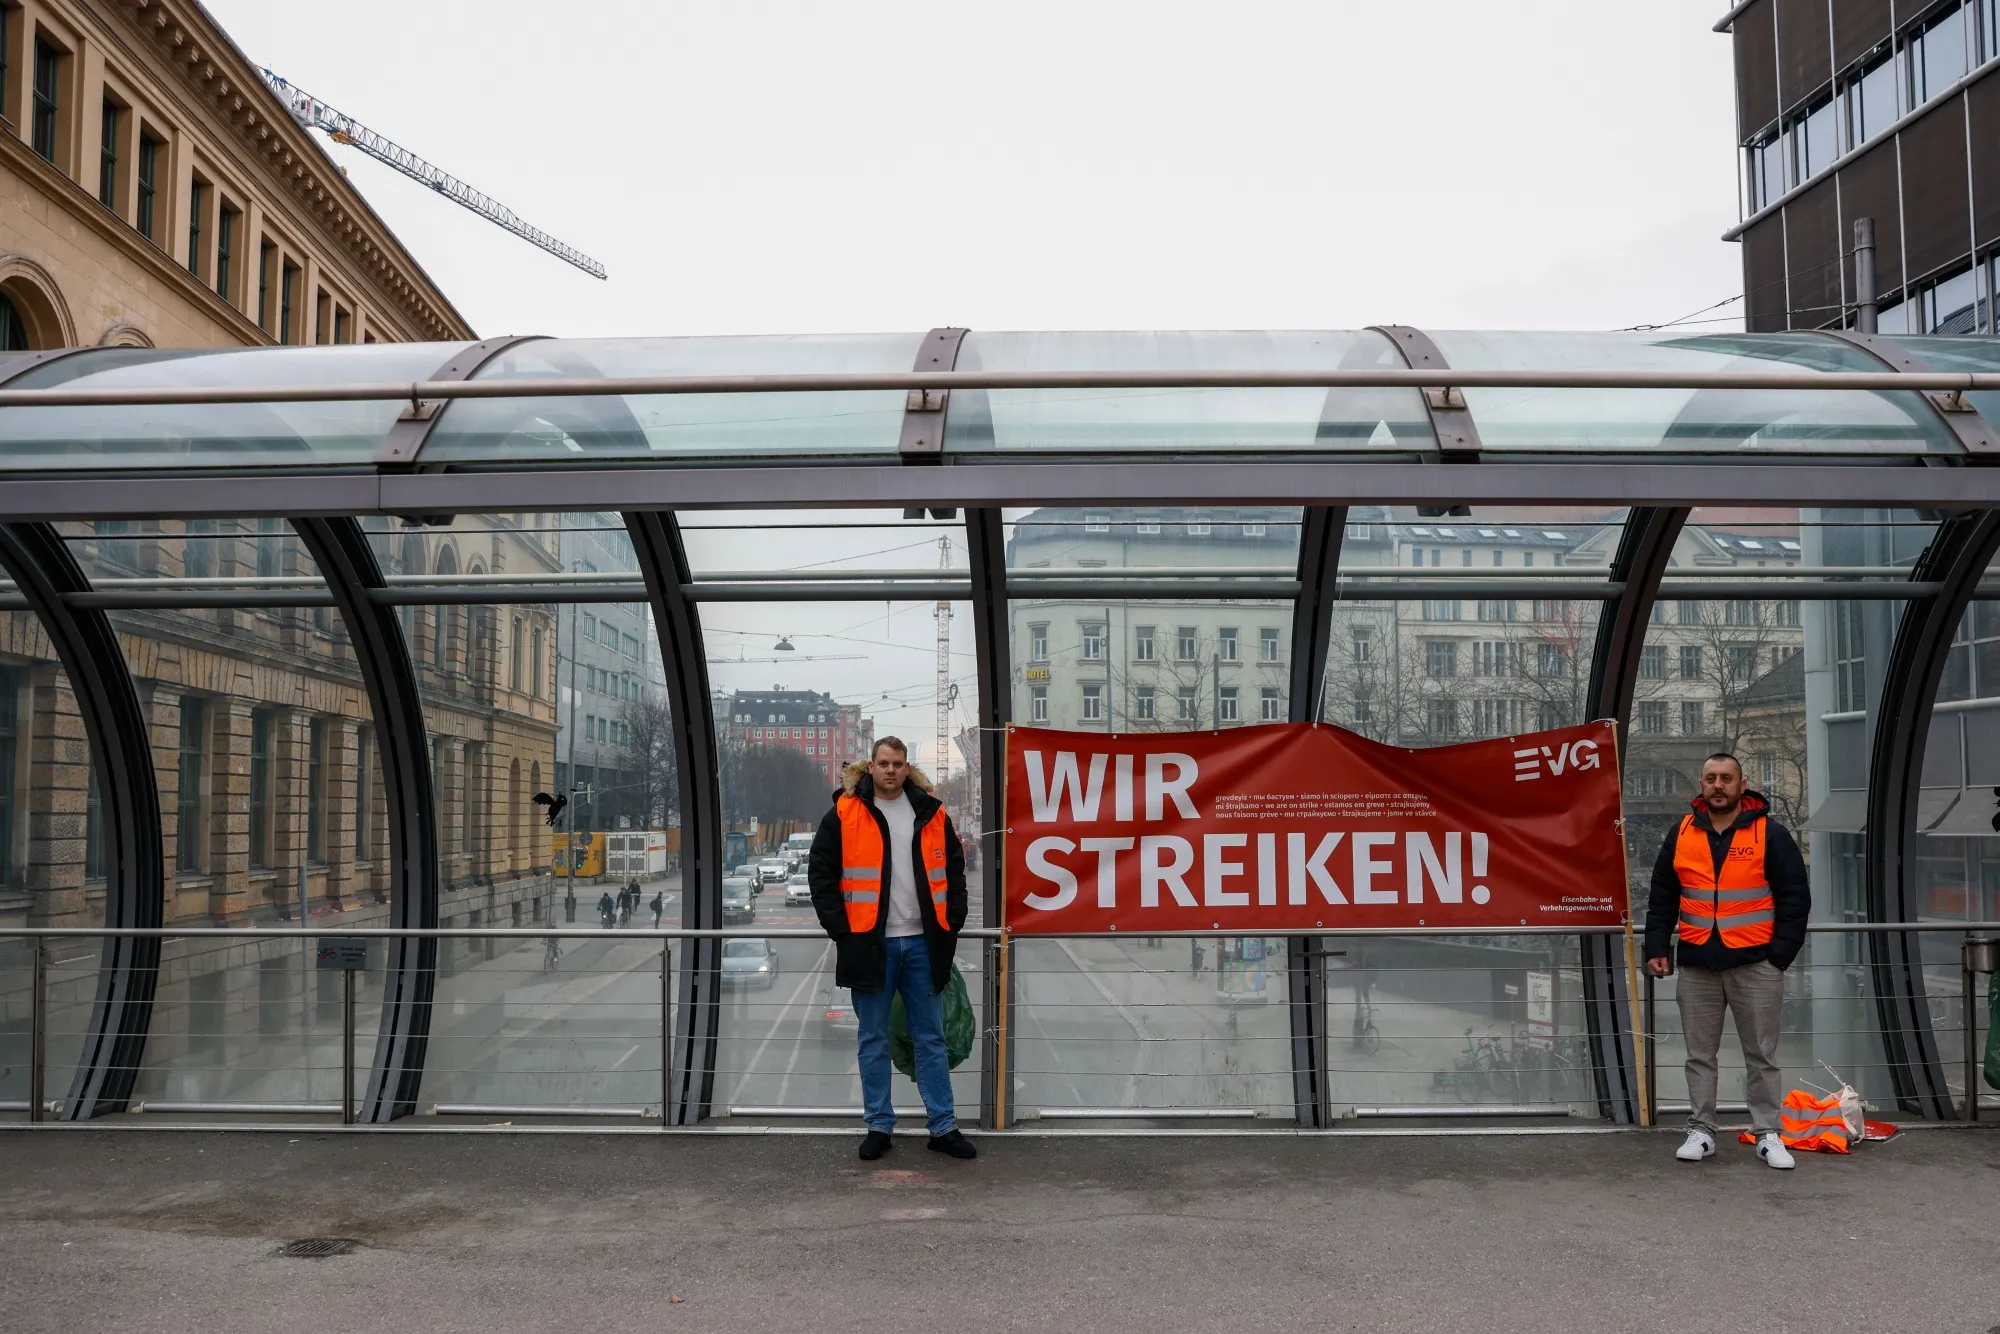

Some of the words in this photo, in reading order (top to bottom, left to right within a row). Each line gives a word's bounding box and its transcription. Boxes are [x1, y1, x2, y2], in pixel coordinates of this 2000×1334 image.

[1026, 668, 1050, 679] HOTEL
[1514, 739, 1600, 781] EVG
[1024, 750, 1201, 823] WIR
[1215, 794, 1248, 803] grevdeyiz
[1300, 792, 1321, 800] siamo
[1330, 792, 1360, 801] sciopero
[1215, 802, 1225, 810] mi
[1225, 802, 1260, 811] štrajkamo
[1299, 801, 1319, 809] strike
[1366, 801, 1385, 809] greve
[1390, 801, 1431, 809] strajkujemy
[1342, 810, 1382, 818] štrajkujeme
[1387, 809, 1404, 818] jsme
[1414, 809, 1437, 817] stávce
[1729, 847, 1754, 856] EVG
[1023, 832, 1491, 911] STREIKEN!
[1539, 904, 1613, 913] Verkehrsgewerkschaft
